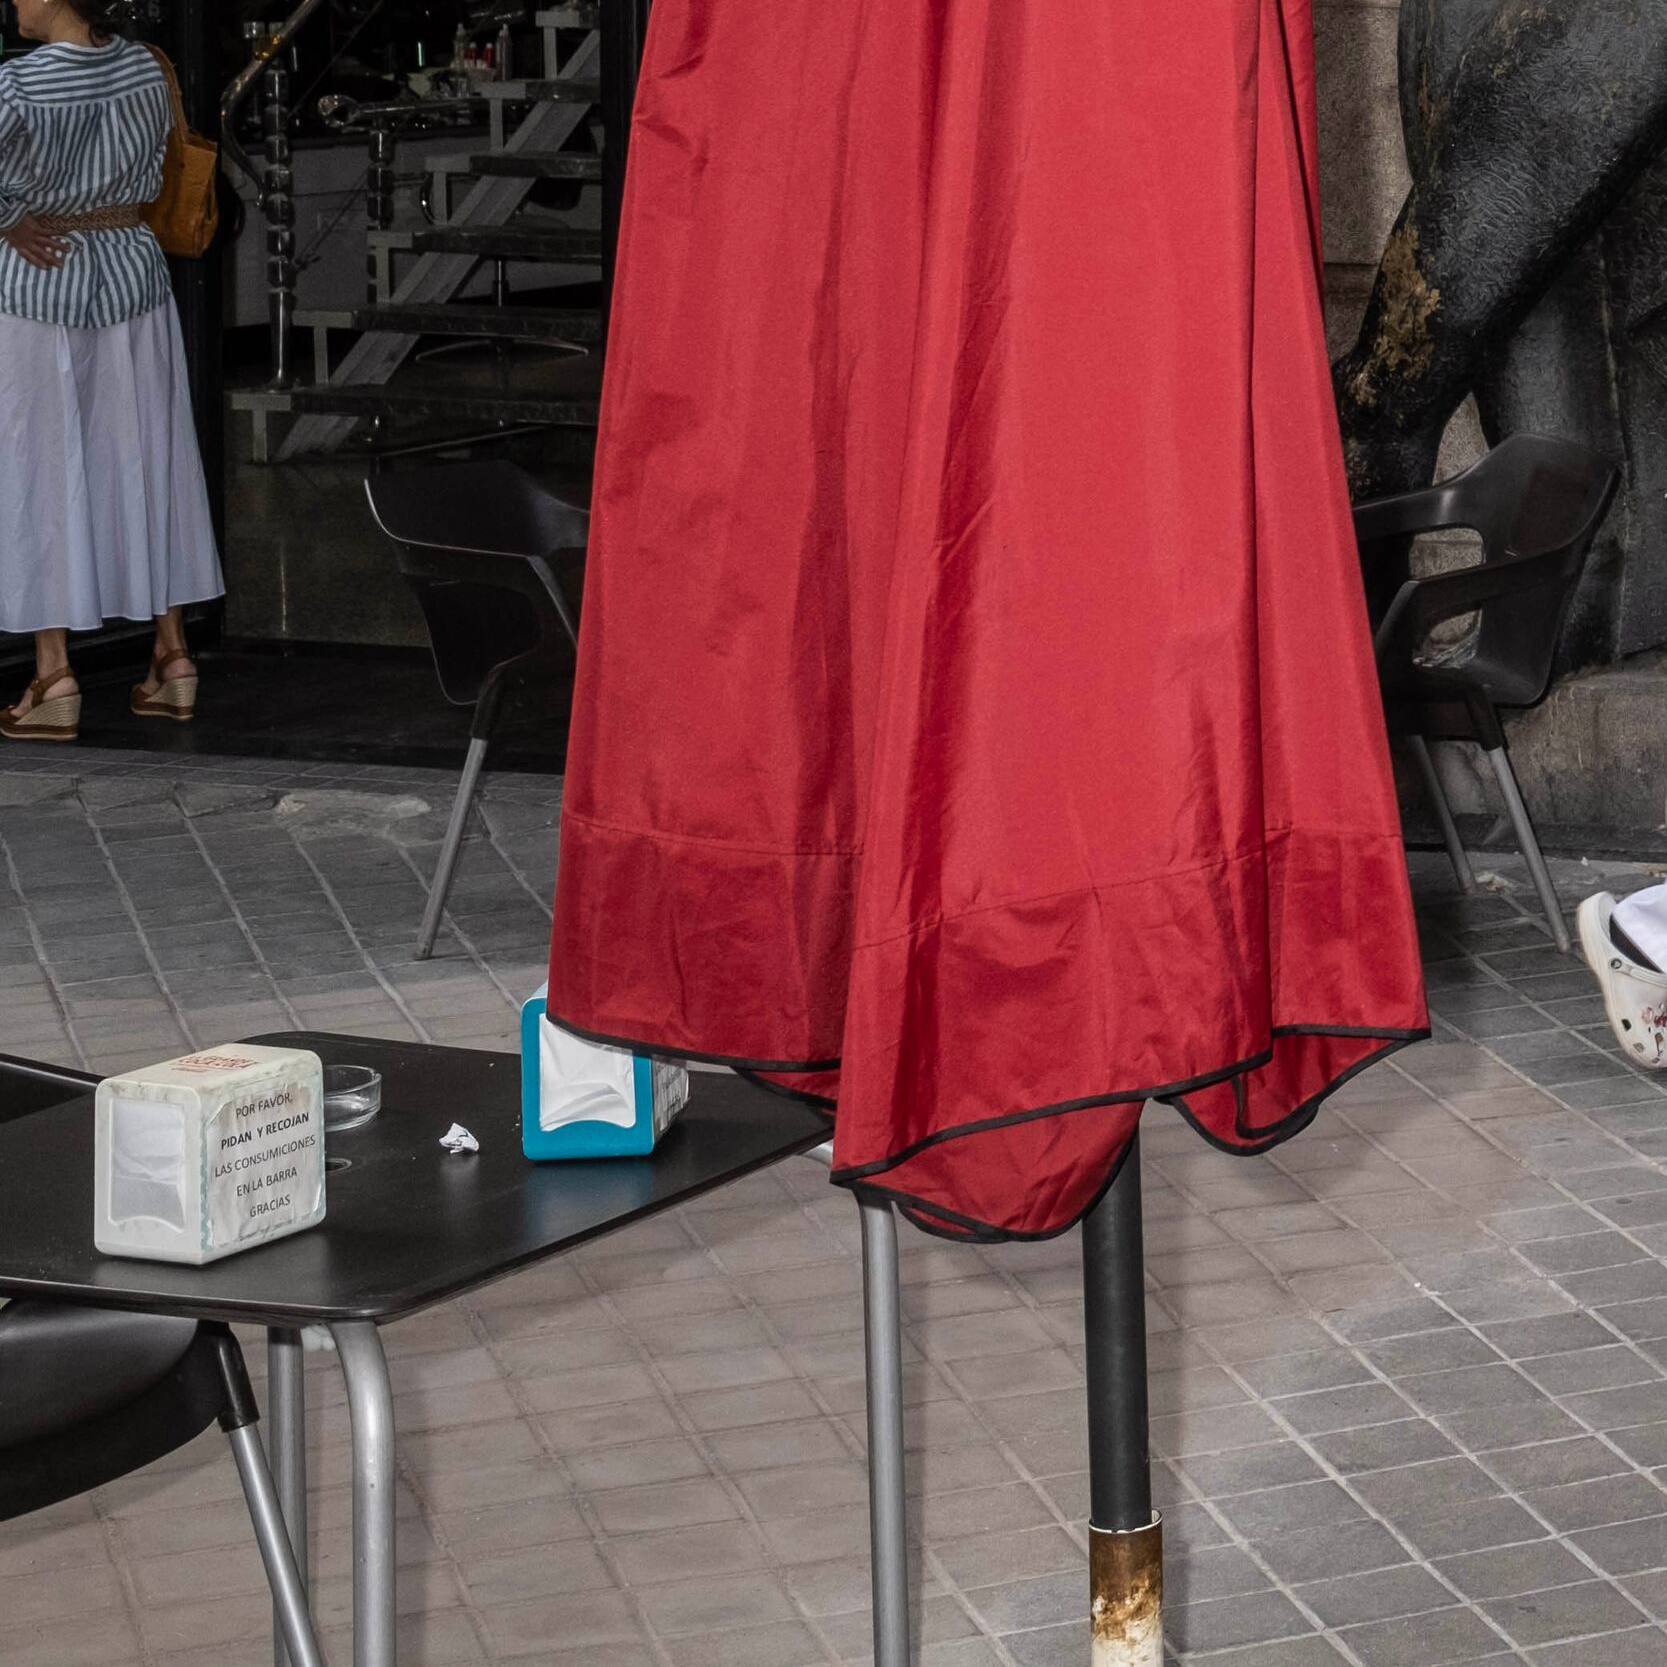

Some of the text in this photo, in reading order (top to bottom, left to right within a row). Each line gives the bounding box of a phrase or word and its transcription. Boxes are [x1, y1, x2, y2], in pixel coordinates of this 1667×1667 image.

[236, 1091, 293, 1119] POR FAVOR,
[221, 1112, 310, 1150] PIDAN Y RECOJAN
[215, 1135, 316, 1178] LAS CONSUMICIONES
[236, 1166, 298, 1197] EN LA BARRA
[250, 1194, 291, 1218] GRACIAS
